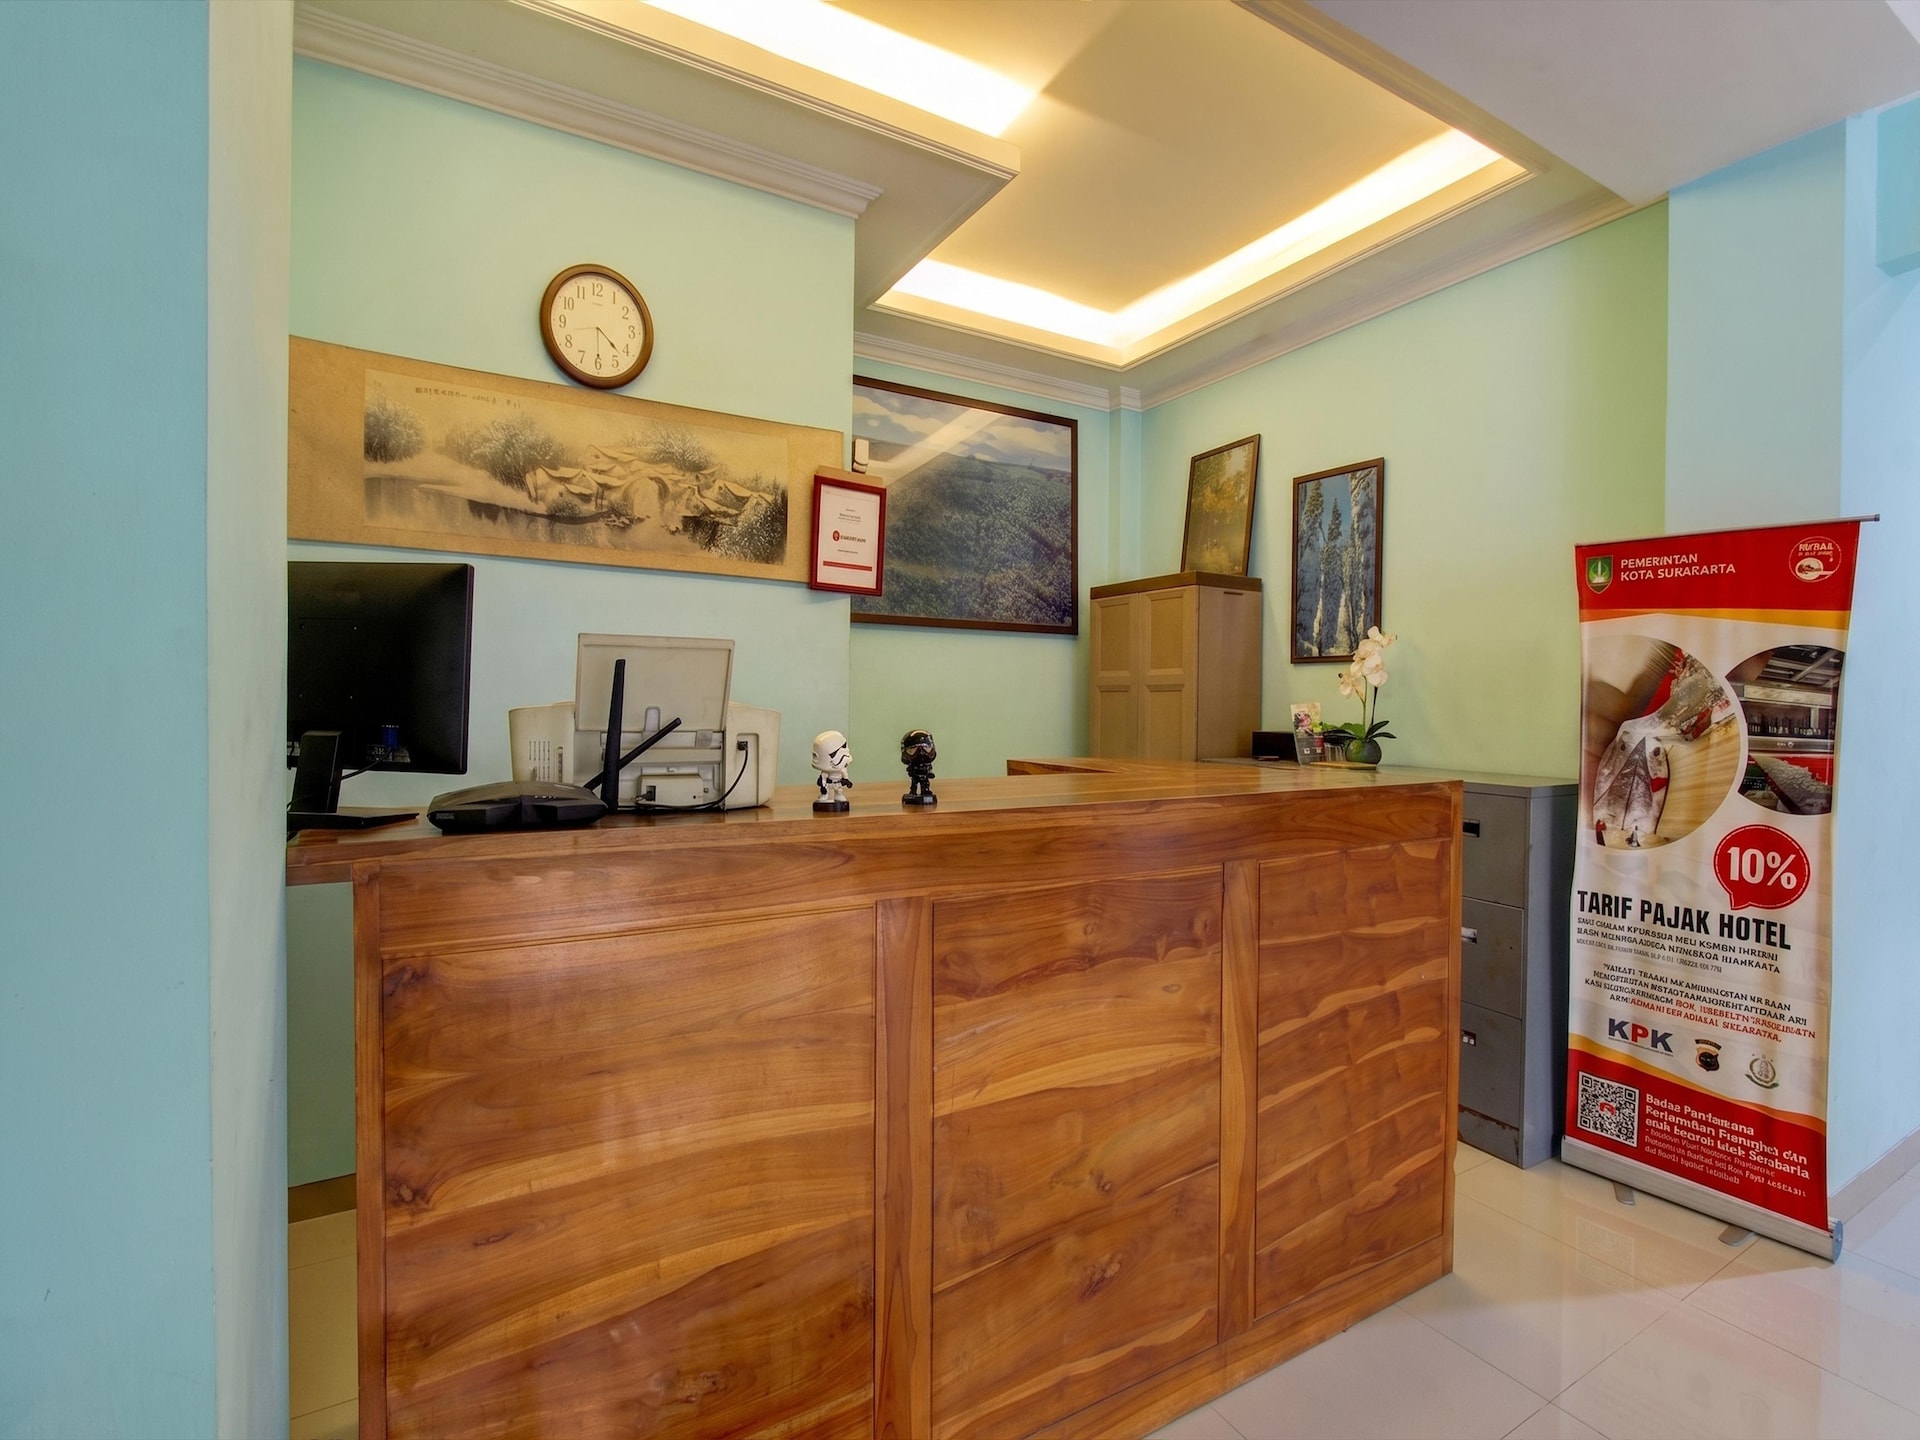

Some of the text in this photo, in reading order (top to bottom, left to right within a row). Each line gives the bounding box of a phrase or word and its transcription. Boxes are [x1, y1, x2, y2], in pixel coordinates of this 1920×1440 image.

[577, 286, 585, 299] 11
[592, 283, 603, 297] 12
[564, 297, 574, 310] 10
[612, 291, 616, 304] 1
[622, 306, 629, 320] 2
[559, 314, 566, 328] 9
[628, 326, 635, 339] 3
[565, 335, 572, 348] 8
[623, 344, 630, 356] 4
[578, 350, 585, 364] 7
[595, 357, 601, 370] 6
[612, 355, 618, 368] 5
[1621, 570, 1654, 581] KOTA
[1727, 846, 1797, 890] 10%
[1578, 890, 1791, 950] TARIF PAJAK HOTEL
[1608, 1018, 1673, 1053] KPK
